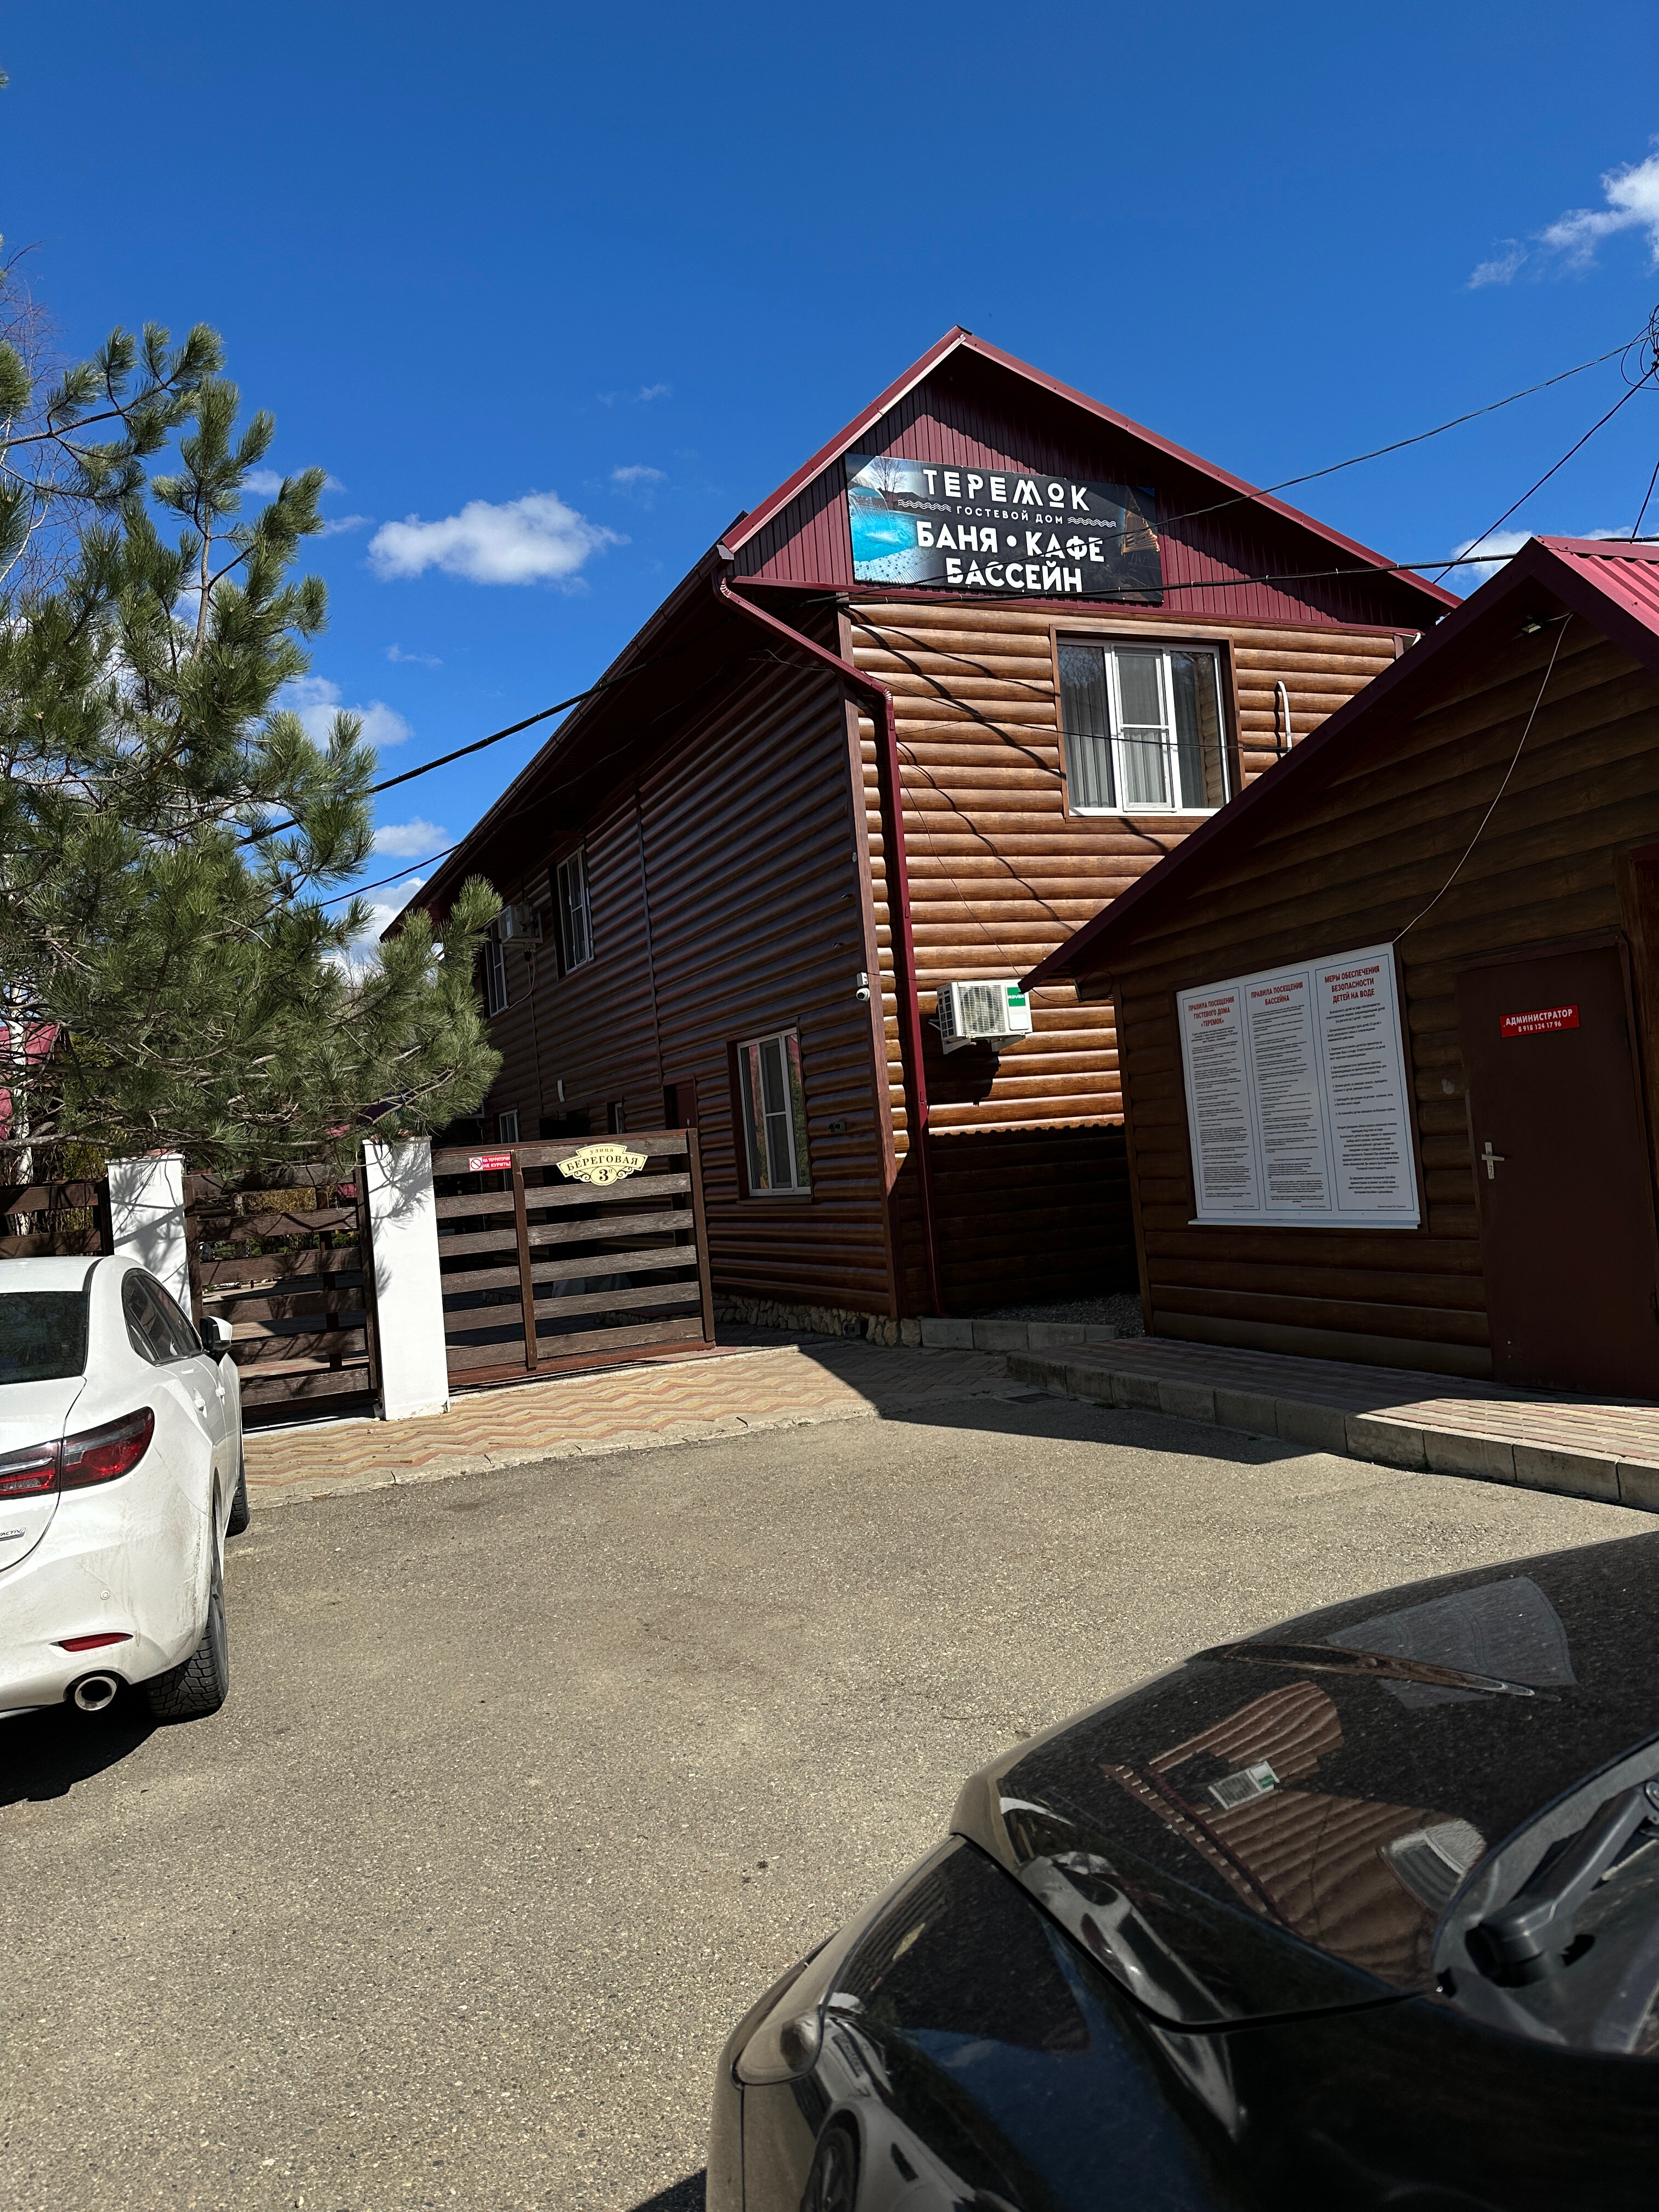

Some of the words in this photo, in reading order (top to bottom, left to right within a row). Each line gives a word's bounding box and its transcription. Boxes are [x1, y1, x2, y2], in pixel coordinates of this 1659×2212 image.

[923, 469, 1090, 511] ТЕРЕМОК
[956, 504, 1029, 521] ГОСТЕВОЙ
[1035, 512, 1063, 524] ДОМ
[916, 521, 998, 553] БАНЯ
[1026, 531, 1104, 562] КАФЕ
[946, 557, 1082, 592] БАССЕЙН
[1325, 974, 1340, 983] МЕРЫ
[1341, 965, 1380, 980] ОБЕСПЕЧЕНИЯ
[1251, 989, 1273, 998] ПРАВИЛА
[1273, 981, 1303, 994] ПОСЕЩЕНИЯ
[1331, 978, 1374, 992] БЕЗОПАСНОСТИ
[1265, 995, 1290, 1005] БАССЕЙНА
[1333, 991, 1350, 1004] ДЕТЕЙ
[1360, 989, 1375, 998] ВОДЕ
[1188, 1002, 1207, 1012] ПРАВИЛА
[1194, 1009, 1217, 1019] ГОСТЕВОГО
[1217, 1007, 1231, 1016] ДОМА
[1506, 1009, 1572, 1025] АДМИНИСТРАТОР
[566, 1155, 639, 1171] БЕРЕГОВАЯ
